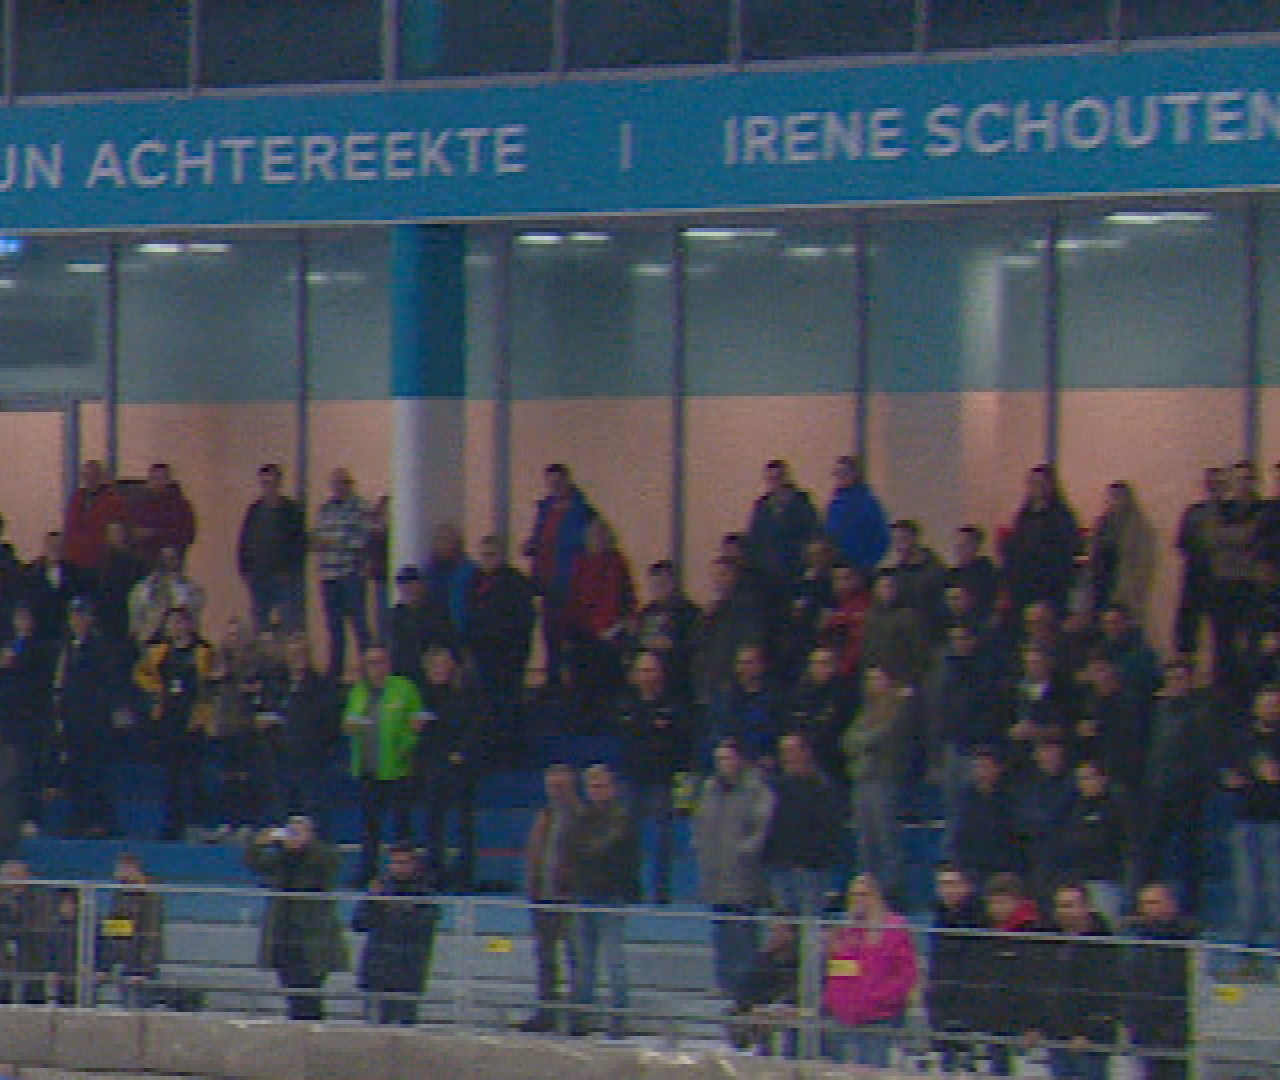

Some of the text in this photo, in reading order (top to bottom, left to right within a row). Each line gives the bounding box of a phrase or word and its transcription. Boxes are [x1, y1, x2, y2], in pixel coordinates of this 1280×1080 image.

[84, 123, 528, 188] ACHTEREEKTE
[724, 90, 1280, 166] IRENE SCHOUTEN
